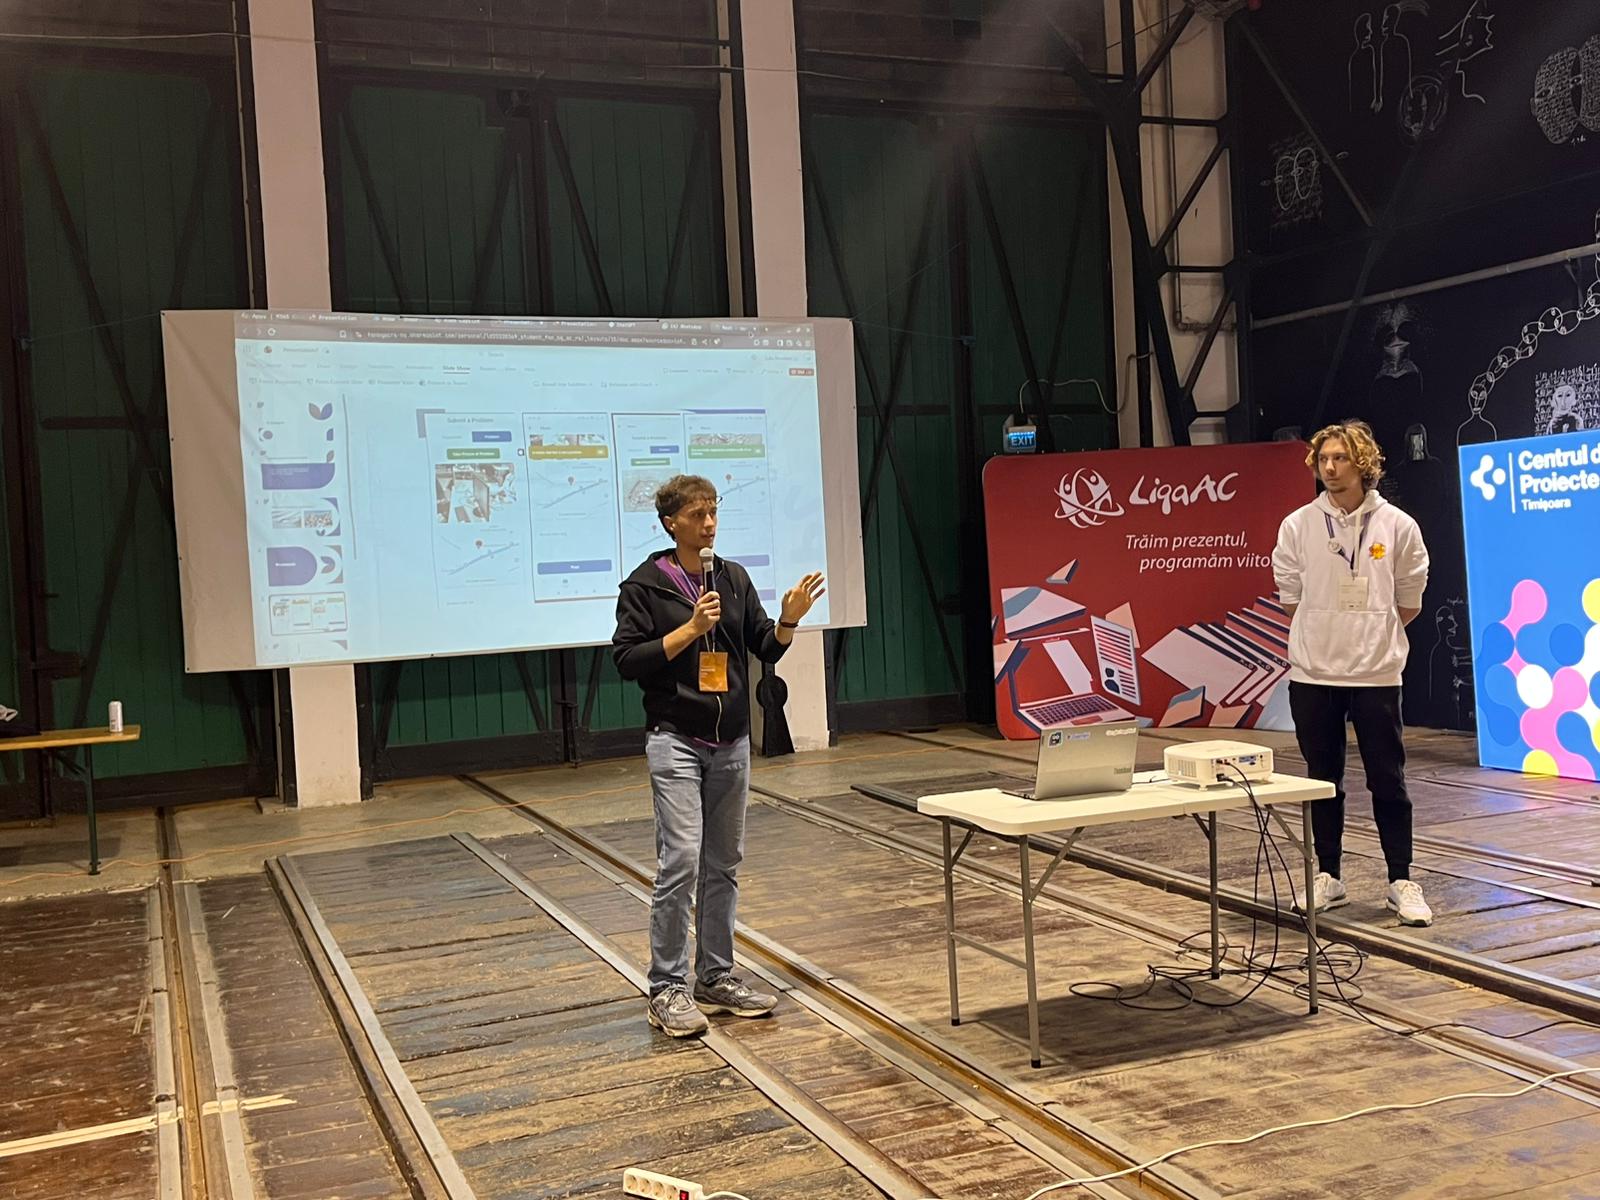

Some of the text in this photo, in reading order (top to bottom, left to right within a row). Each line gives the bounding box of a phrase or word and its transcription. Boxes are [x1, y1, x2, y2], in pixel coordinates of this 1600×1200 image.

[1011, 435, 1034, 446] EXIT
[1518, 444, 1588, 471] Centrul
[1520, 469, 1600, 494] Proiecte
[1126, 531, 1248, 552] Trăim prezentul,
[1139, 552, 1272, 573] programăm viito
